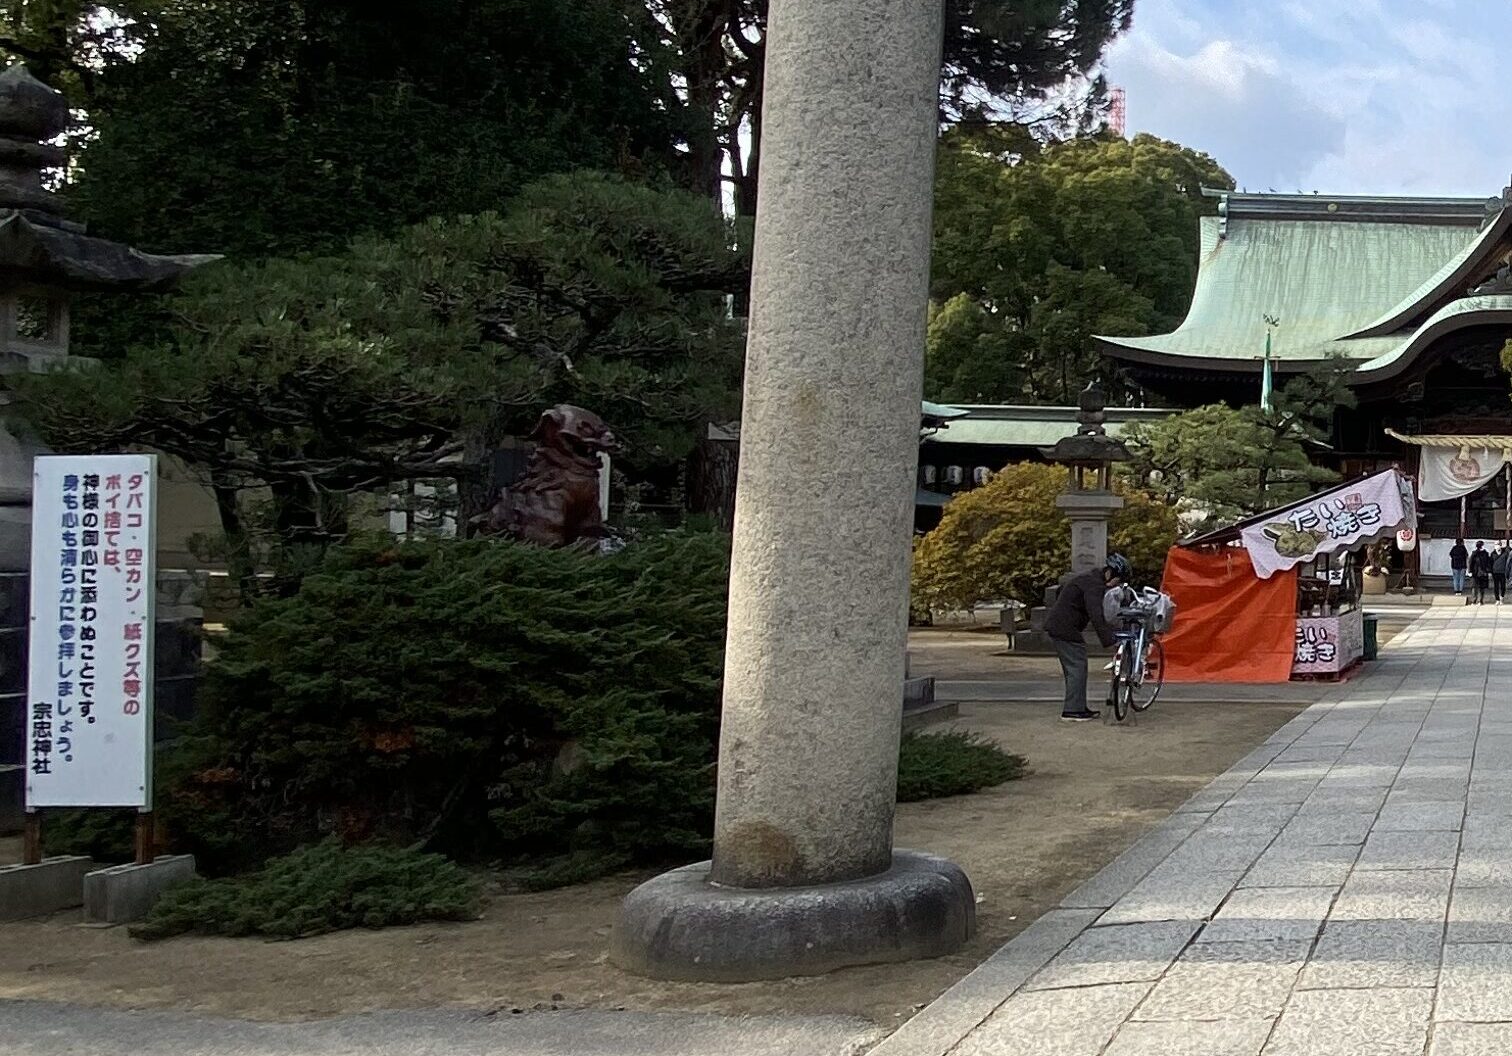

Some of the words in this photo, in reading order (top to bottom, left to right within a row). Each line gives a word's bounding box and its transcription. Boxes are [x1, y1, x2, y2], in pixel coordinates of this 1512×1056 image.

[1288, 498, 1346, 532] たい
[1326, 502, 1381, 539] 焼き
[1294, 642, 1336, 663] 焼き
[32, 701, 53, 775] 宗忠神社
